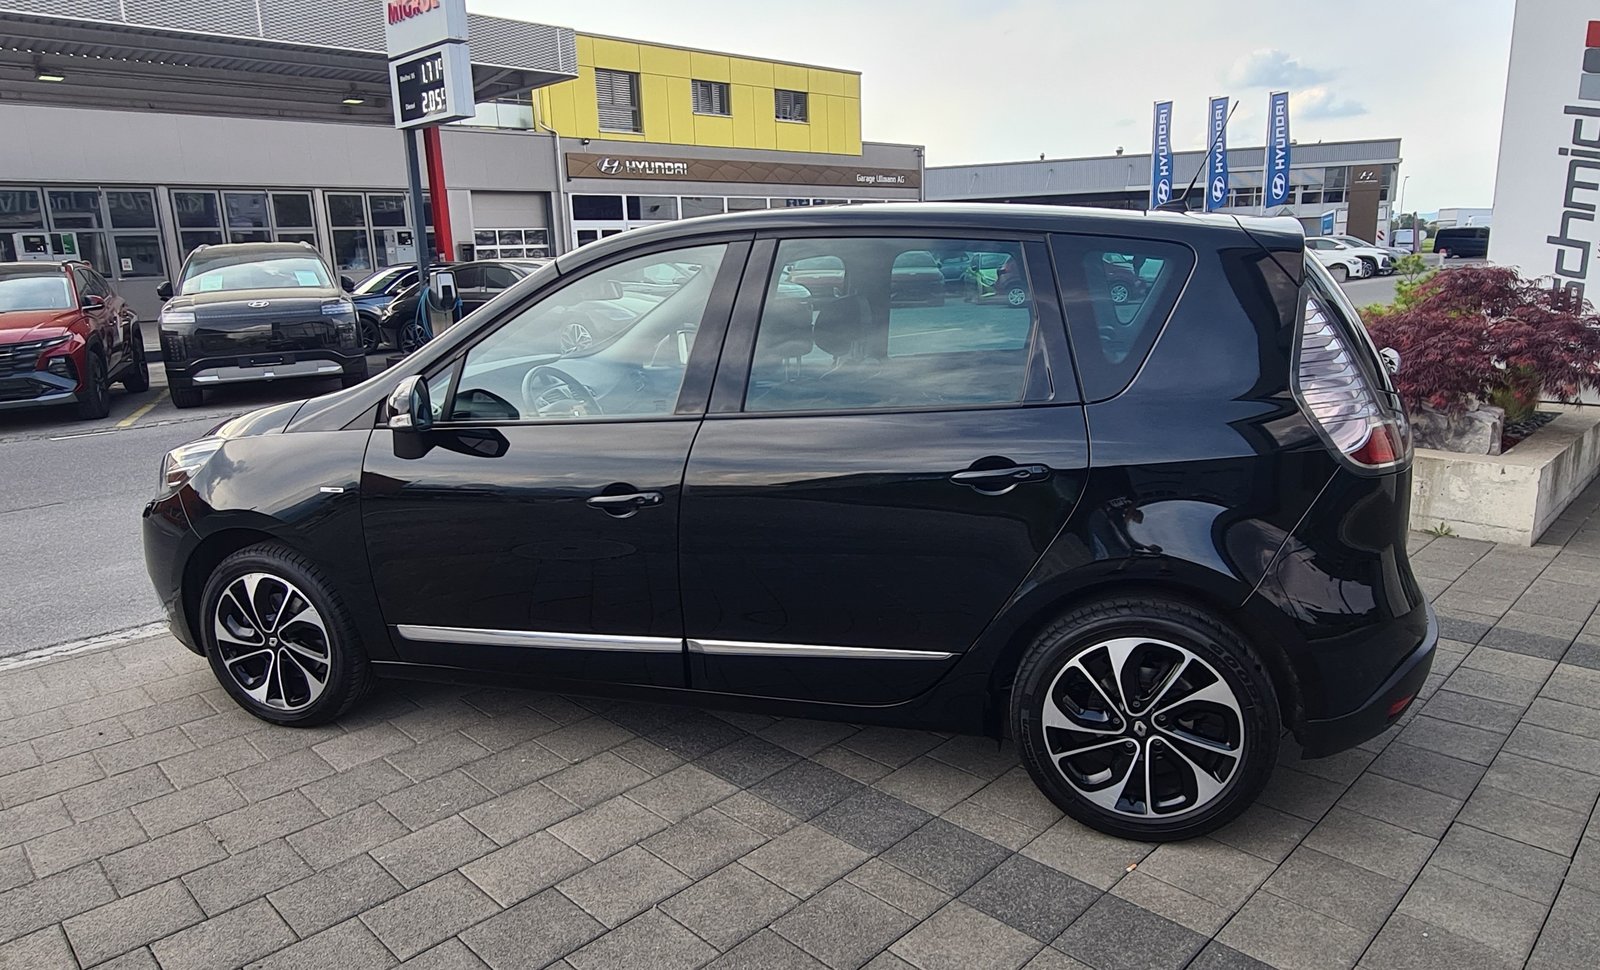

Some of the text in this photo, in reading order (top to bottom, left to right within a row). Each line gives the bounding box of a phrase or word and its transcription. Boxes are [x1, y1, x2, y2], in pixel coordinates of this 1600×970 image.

[1158, 109, 1169, 176] HYUNDAI
[1274, 99, 1286, 170] HYUNDAI
[625, 160, 688, 175] HYUNDAI
[856, 174, 875, 184] Garage
[897, 175, 905, 184] AG
